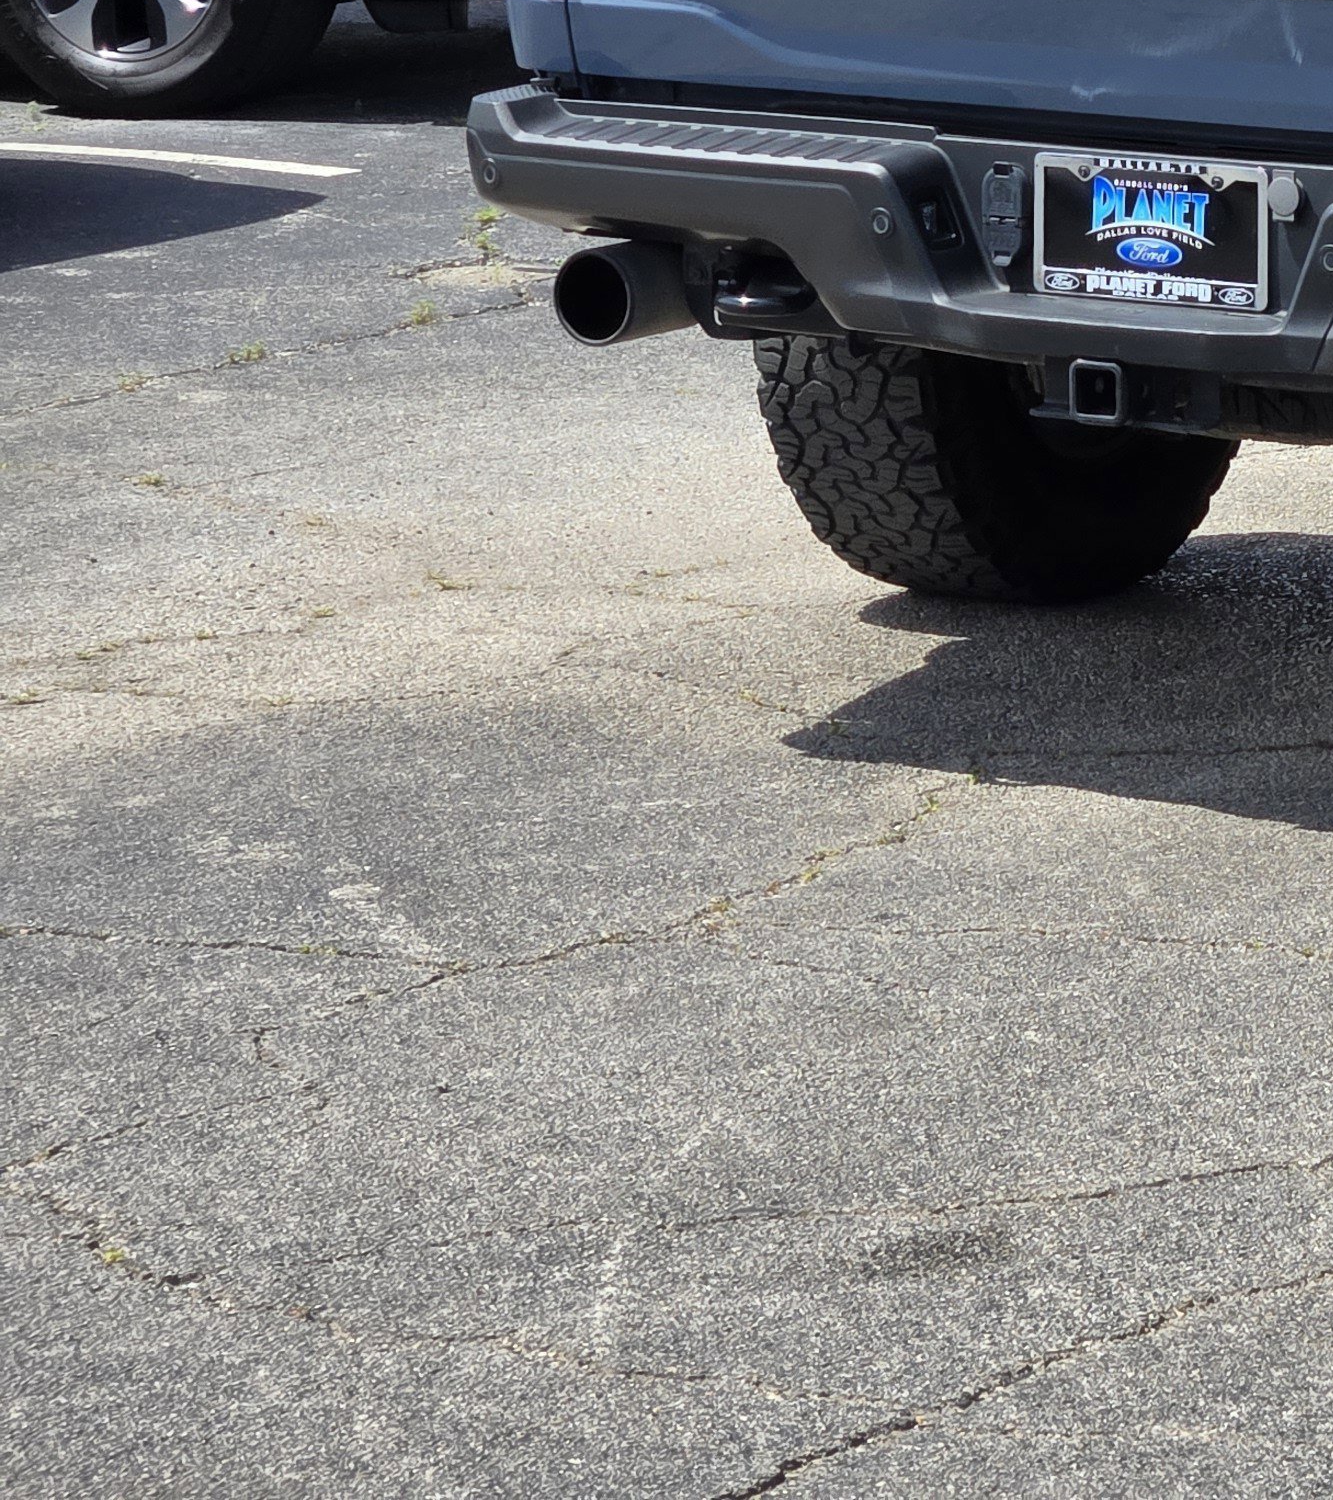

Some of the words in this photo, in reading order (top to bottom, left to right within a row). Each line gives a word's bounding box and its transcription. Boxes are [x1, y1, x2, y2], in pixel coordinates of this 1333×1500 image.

[1092, 175, 1209, 236] PLANET
[1096, 226, 1137, 242] DALLAS
[1140, 226, 1169, 238] LOVE
[1171, 231, 1203, 250] FIELD
[1128, 241, 1170, 263] Ford
[1086, 274, 1157, 293] PLANET
[1162, 281, 1212, 302] FORD
